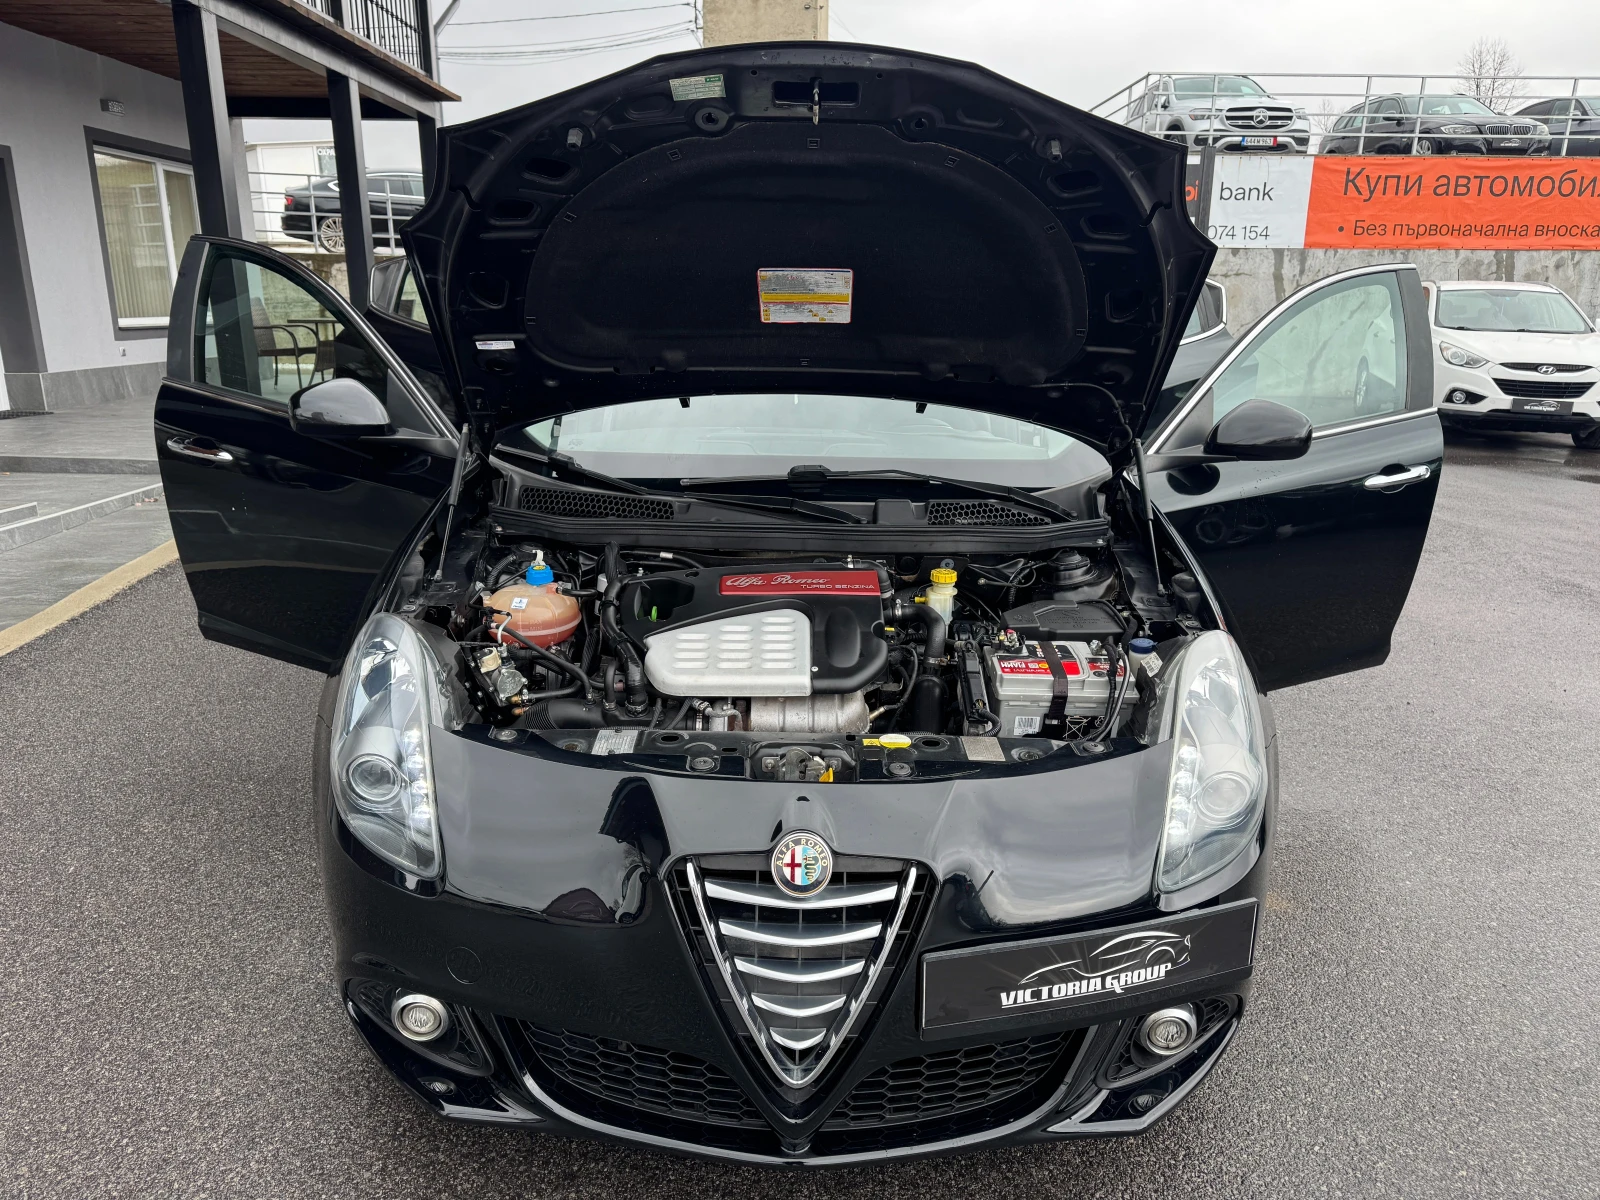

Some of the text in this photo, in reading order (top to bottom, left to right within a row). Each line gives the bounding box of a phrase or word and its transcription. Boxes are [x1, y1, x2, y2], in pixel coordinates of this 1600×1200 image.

[1219, 182, 1274, 201] bank
[1343, 167, 1600, 203] Купи автомоби
[1207, 225, 1270, 240] 074 154
[1353, 219, 1600, 240] Без първоначална вноска
[725, 574, 832, 588] Alfa Romeo
[776, 838, 828, 867] ALFA ROMEO
[1000, 962, 1172, 1006] VICTORIA GROUP
